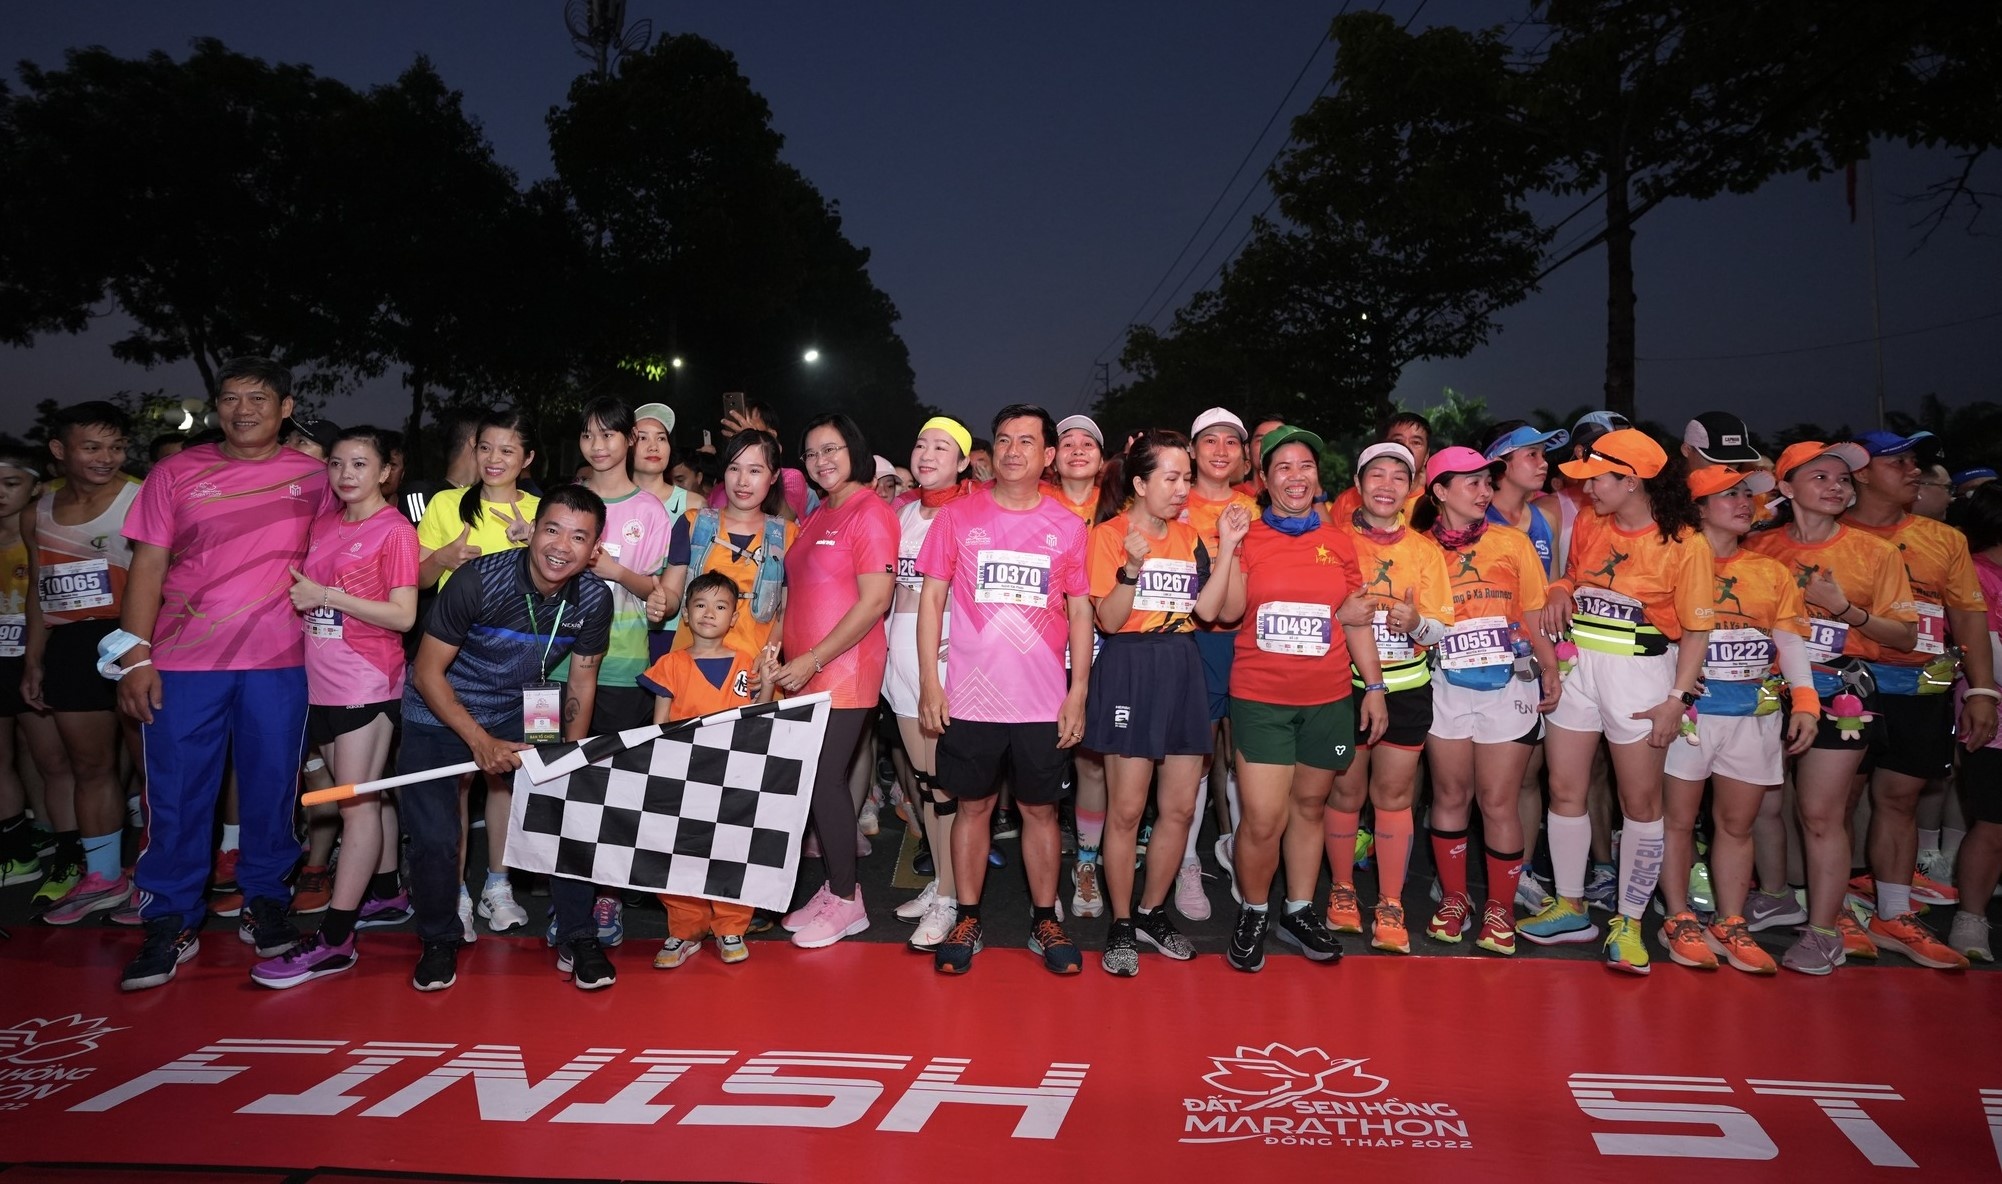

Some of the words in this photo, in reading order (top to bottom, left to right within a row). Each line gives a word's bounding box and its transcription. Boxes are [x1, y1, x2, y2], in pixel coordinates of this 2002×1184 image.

[45, 572, 100, 595] 10065
[986, 564, 1041, 586] 10370
[1141, 571, 1191, 592] 10267
[1266, 615, 1323, 636] 10492
[1447, 629, 1501, 653] 10551
[1708, 641, 1769, 661] 10222
[65, 1038, 1090, 1139] FINISH
[1182, 1095, 1242, 1113] ĐẤT
[1295, 1100, 1360, 1116] SEN
[1365, 1097, 1458, 1117] HỒNG
[1184, 1115, 1470, 1137] MARATHON
[1567, 1073, 2002, 1172] ST
[1263, 1135, 1332, 1146] ĐỒNG
[1341, 1136, 1405, 1148] THÁP
[1411, 1140, 1474, 1149] 2022
